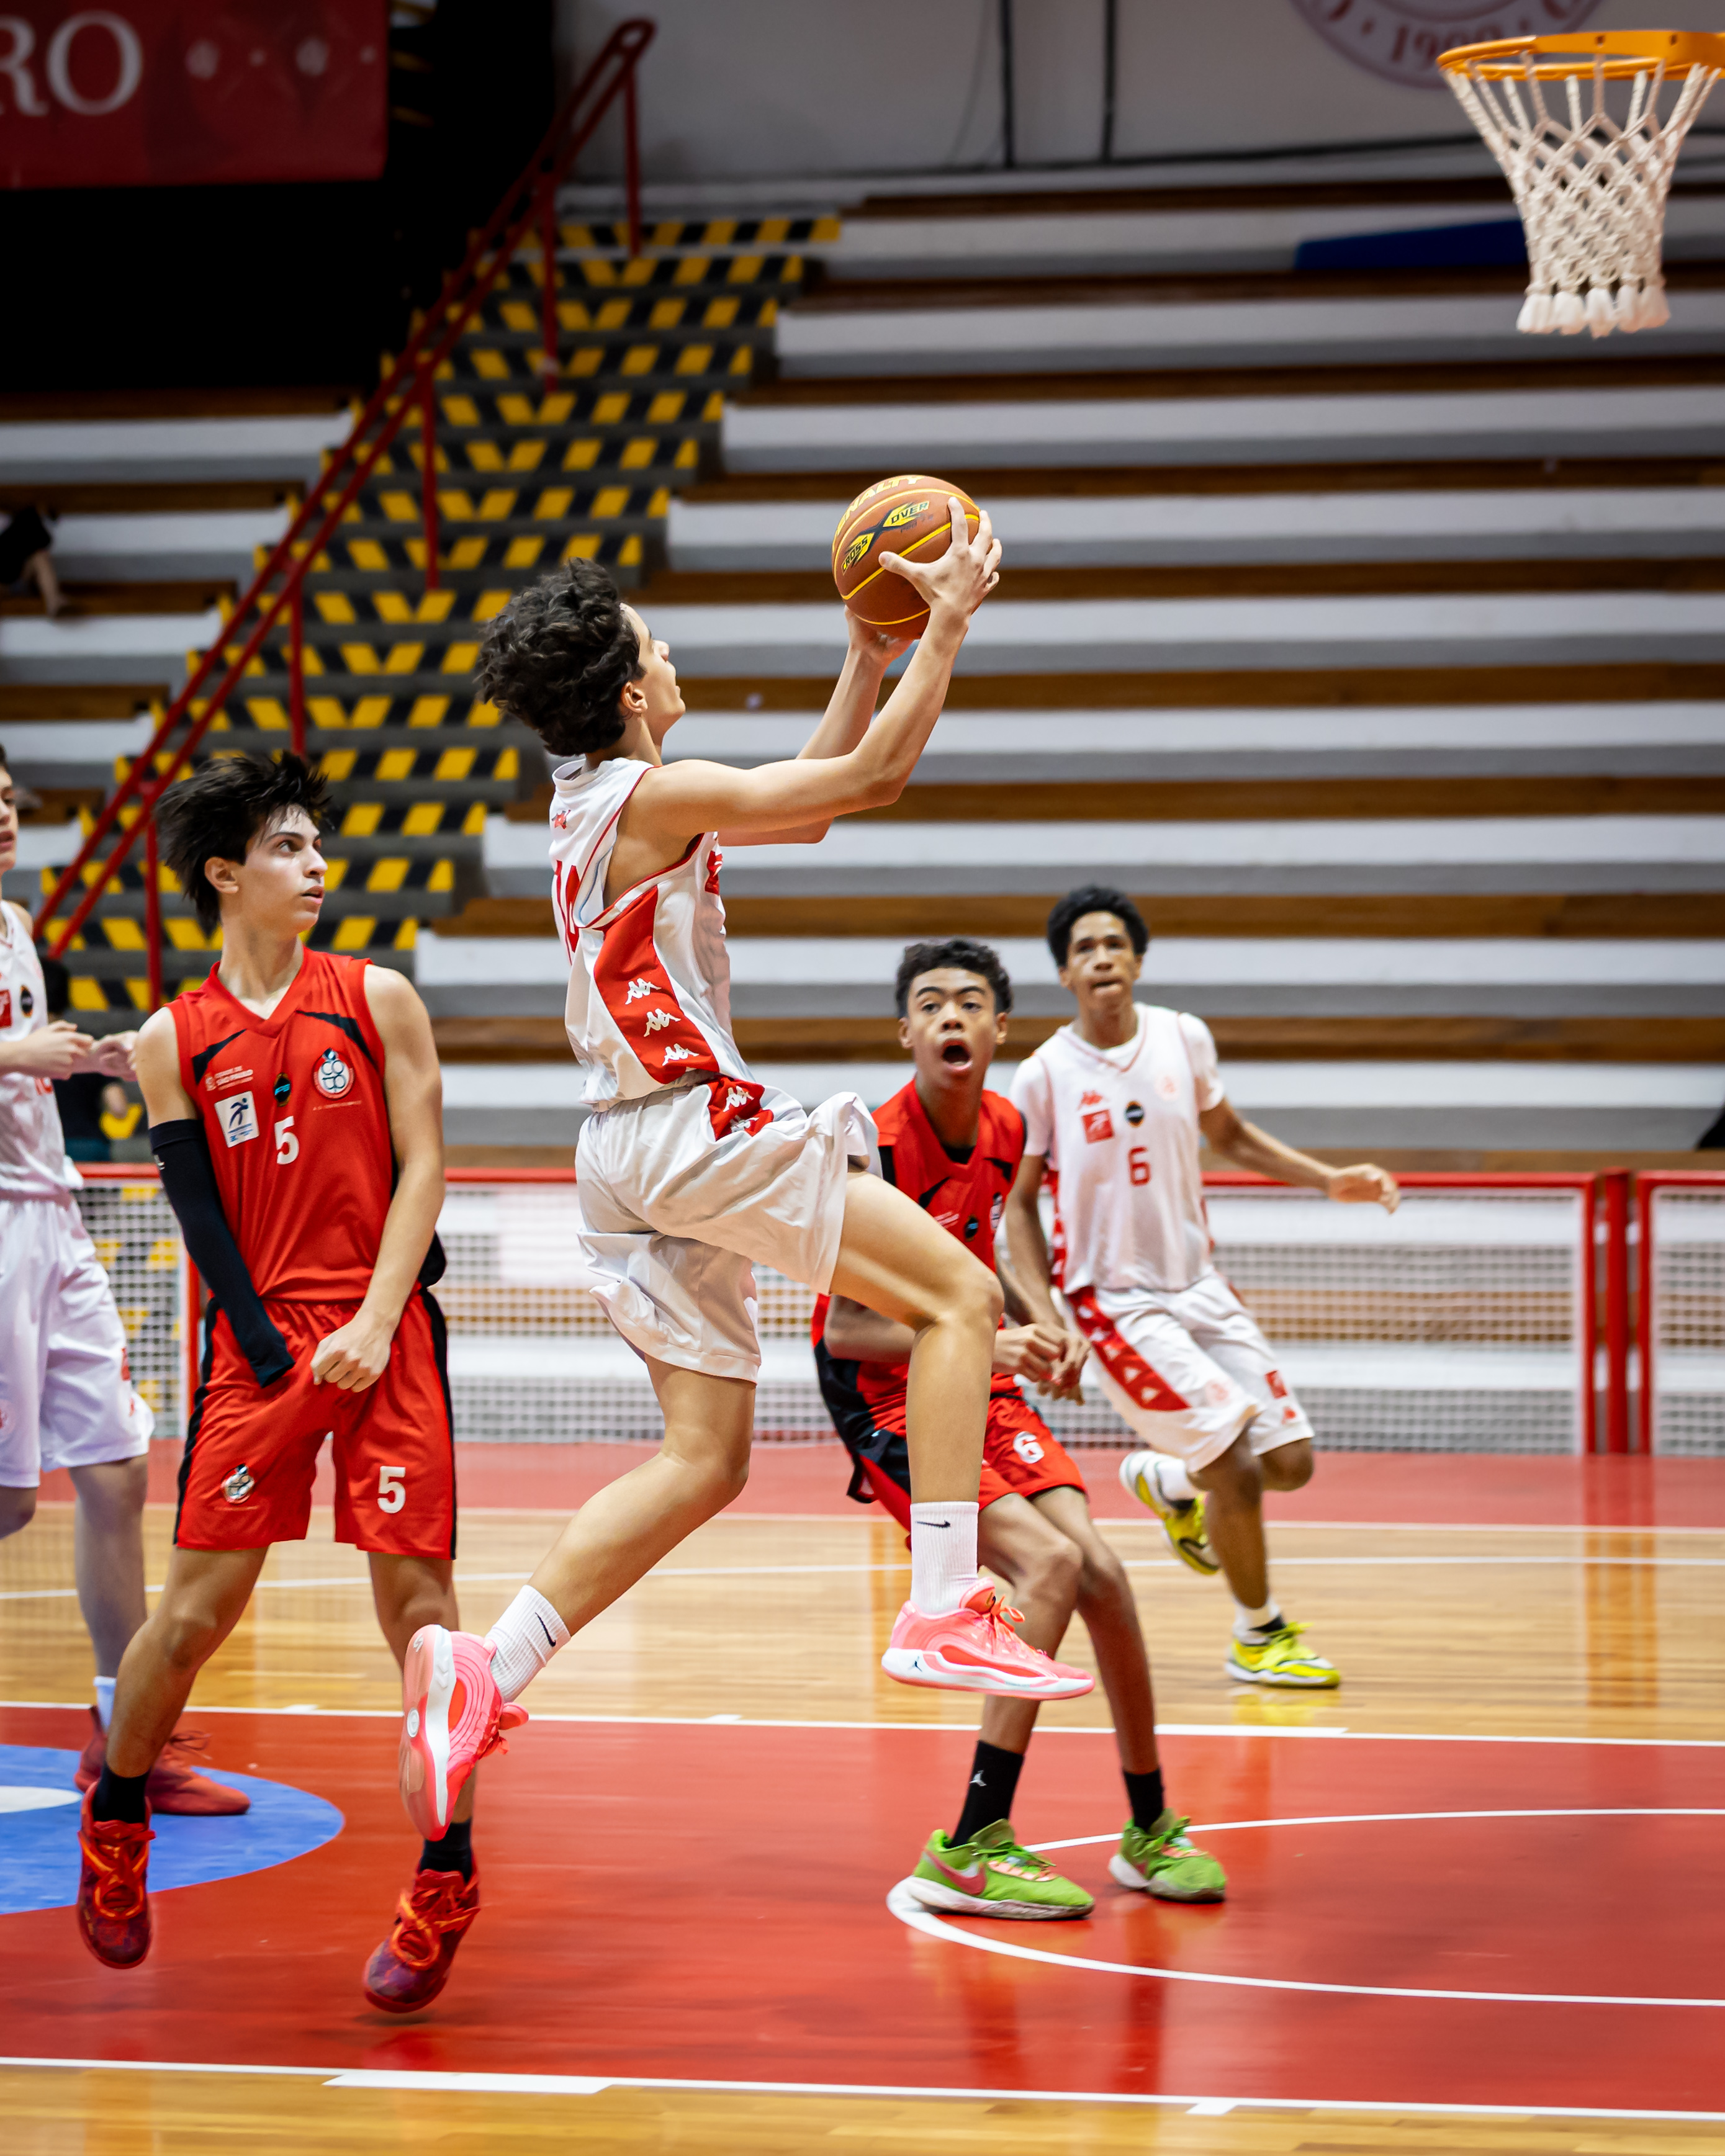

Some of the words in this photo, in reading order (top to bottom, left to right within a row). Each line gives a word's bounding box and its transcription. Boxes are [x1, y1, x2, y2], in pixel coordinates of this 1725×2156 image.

[0, 10, 143, 116] RO
[832, 475, 925, 552] ENALTY
[842, 537, 868, 572] CROSS
[891, 502, 928, 524] OVER
[274, 1115, 299, 1165] 5
[1127, 1146, 1151, 1187] 6
[1012, 1431, 1045, 1464] 6
[377, 1465, 407, 1514] 5
